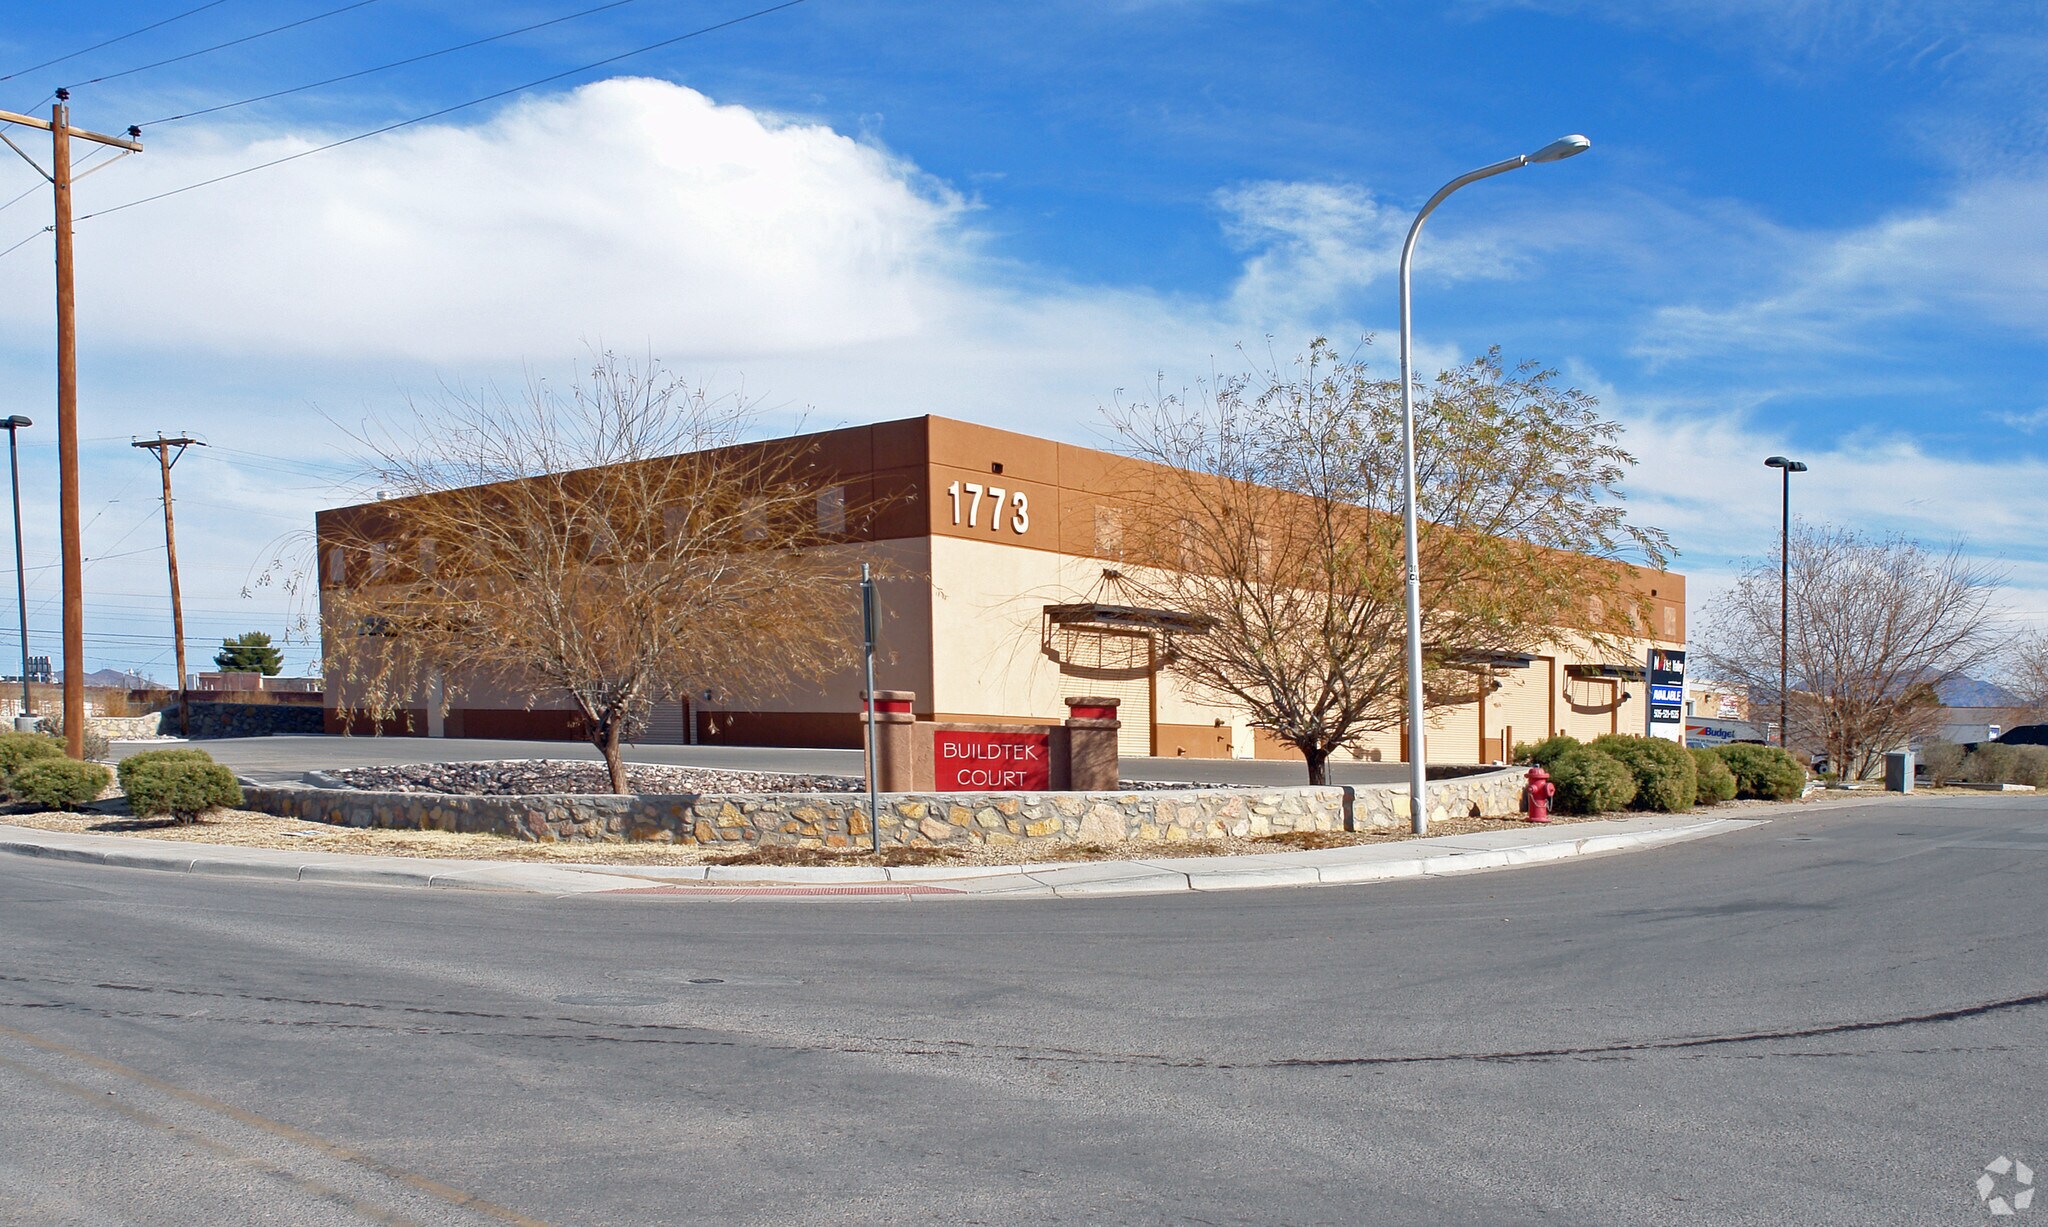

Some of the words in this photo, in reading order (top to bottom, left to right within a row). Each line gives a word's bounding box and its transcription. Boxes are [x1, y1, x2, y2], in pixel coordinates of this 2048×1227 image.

[947, 480, 1029, 534] 1773
[1653, 690, 1681, 701] AVAILABLE
[1705, 727, 1734, 739] Budget
[943, 742, 1038, 761] BUILDTEK
[957, 769, 1028, 787] COURT
